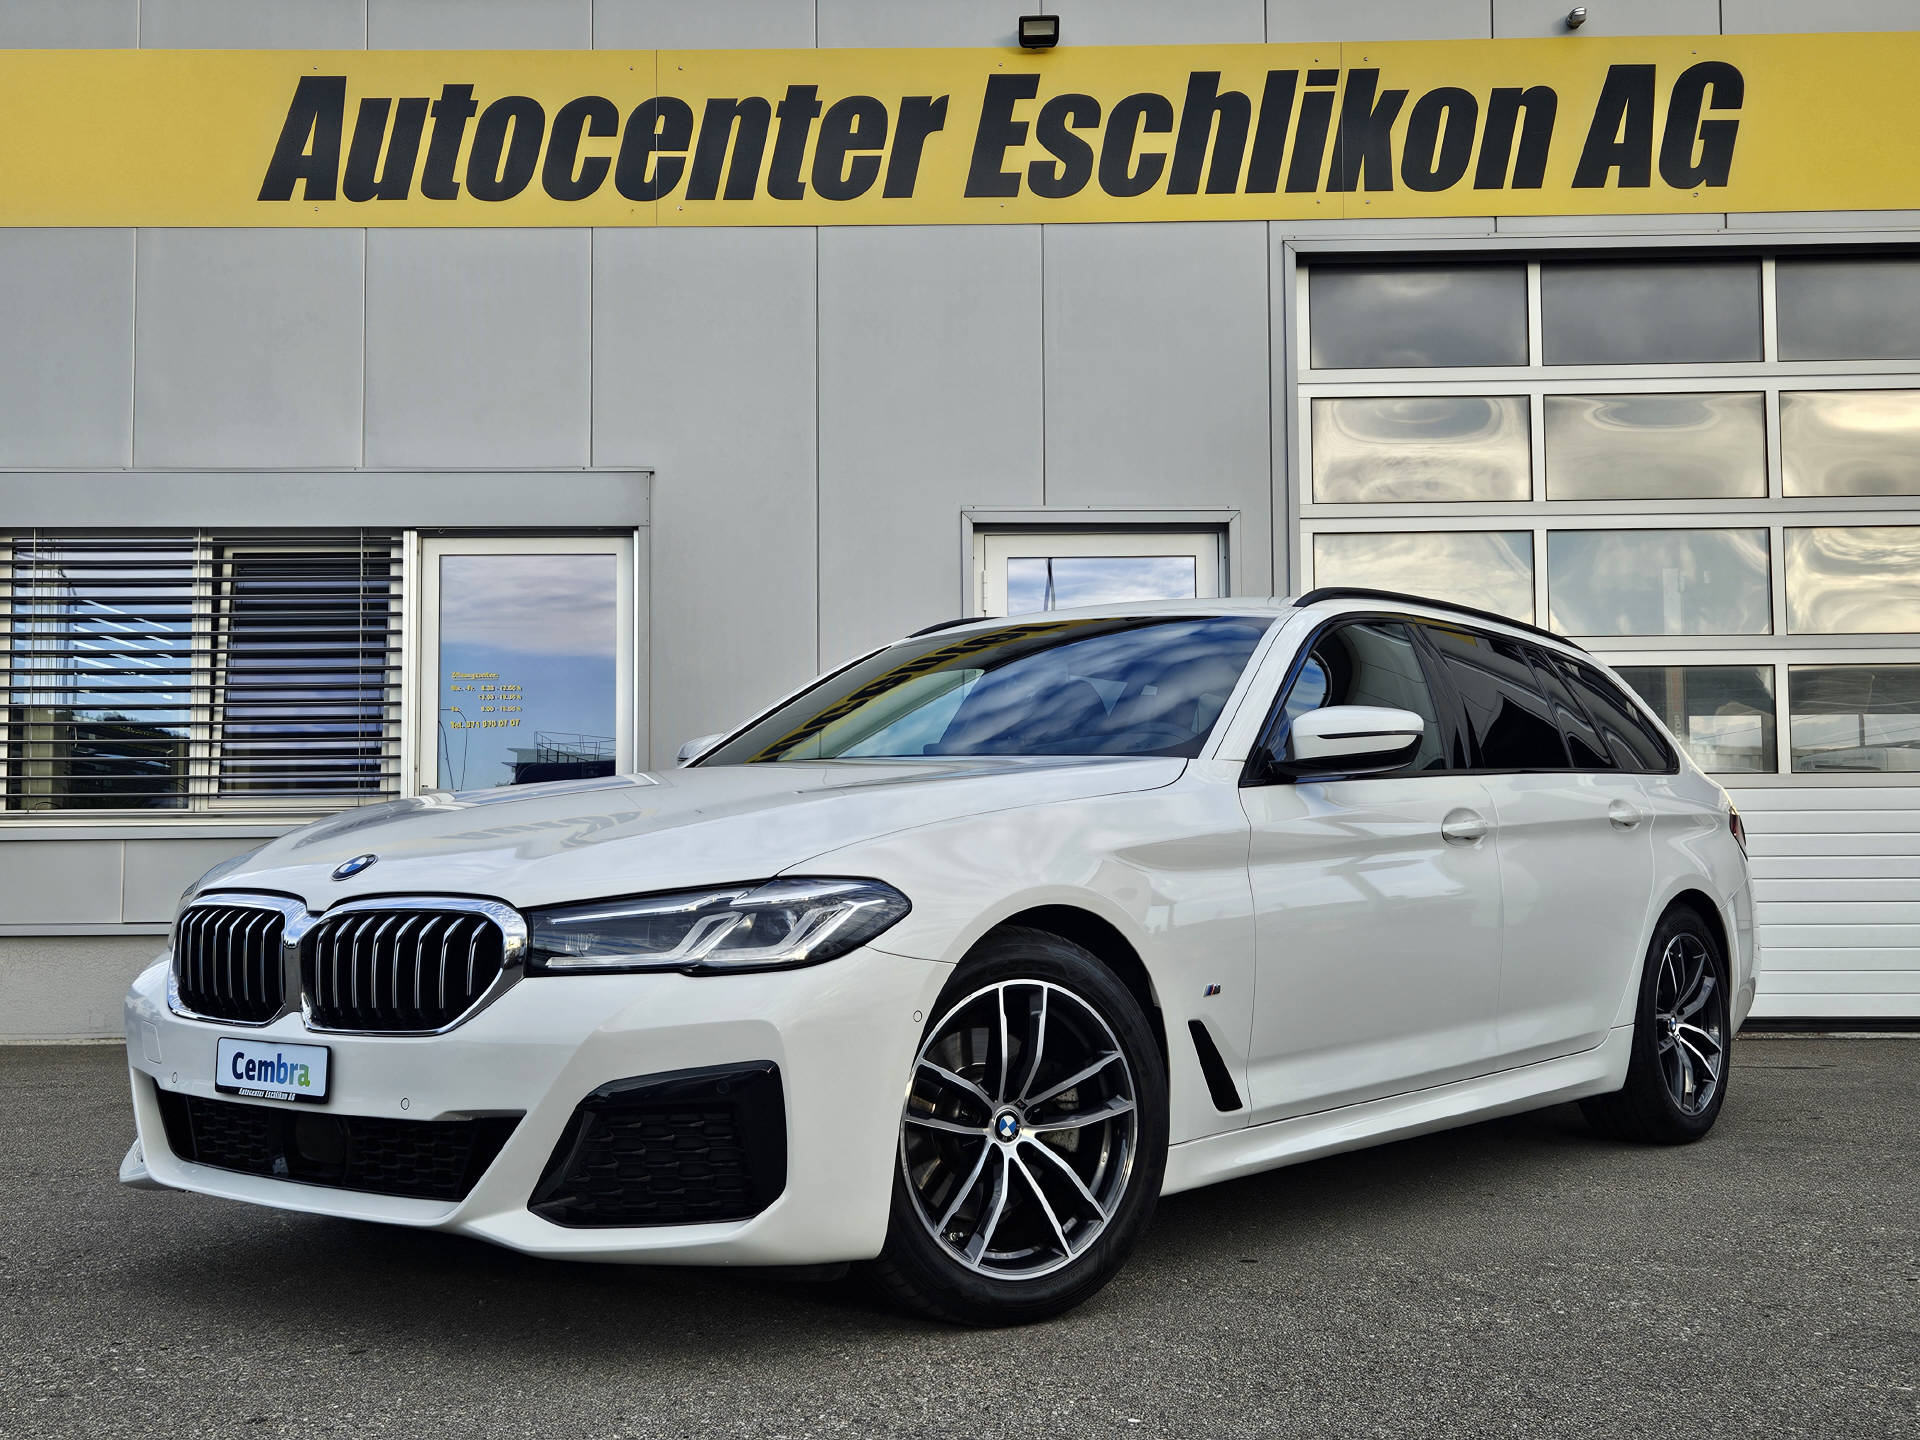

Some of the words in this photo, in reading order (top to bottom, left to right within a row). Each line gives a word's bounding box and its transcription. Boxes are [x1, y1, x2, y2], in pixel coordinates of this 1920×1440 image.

[257, 75, 950, 202] Autocenter
[963, 67, 1558, 198] Eschlikon
[1571, 60, 1745, 191] AG
[232, 1051, 311, 1088] Cembra
